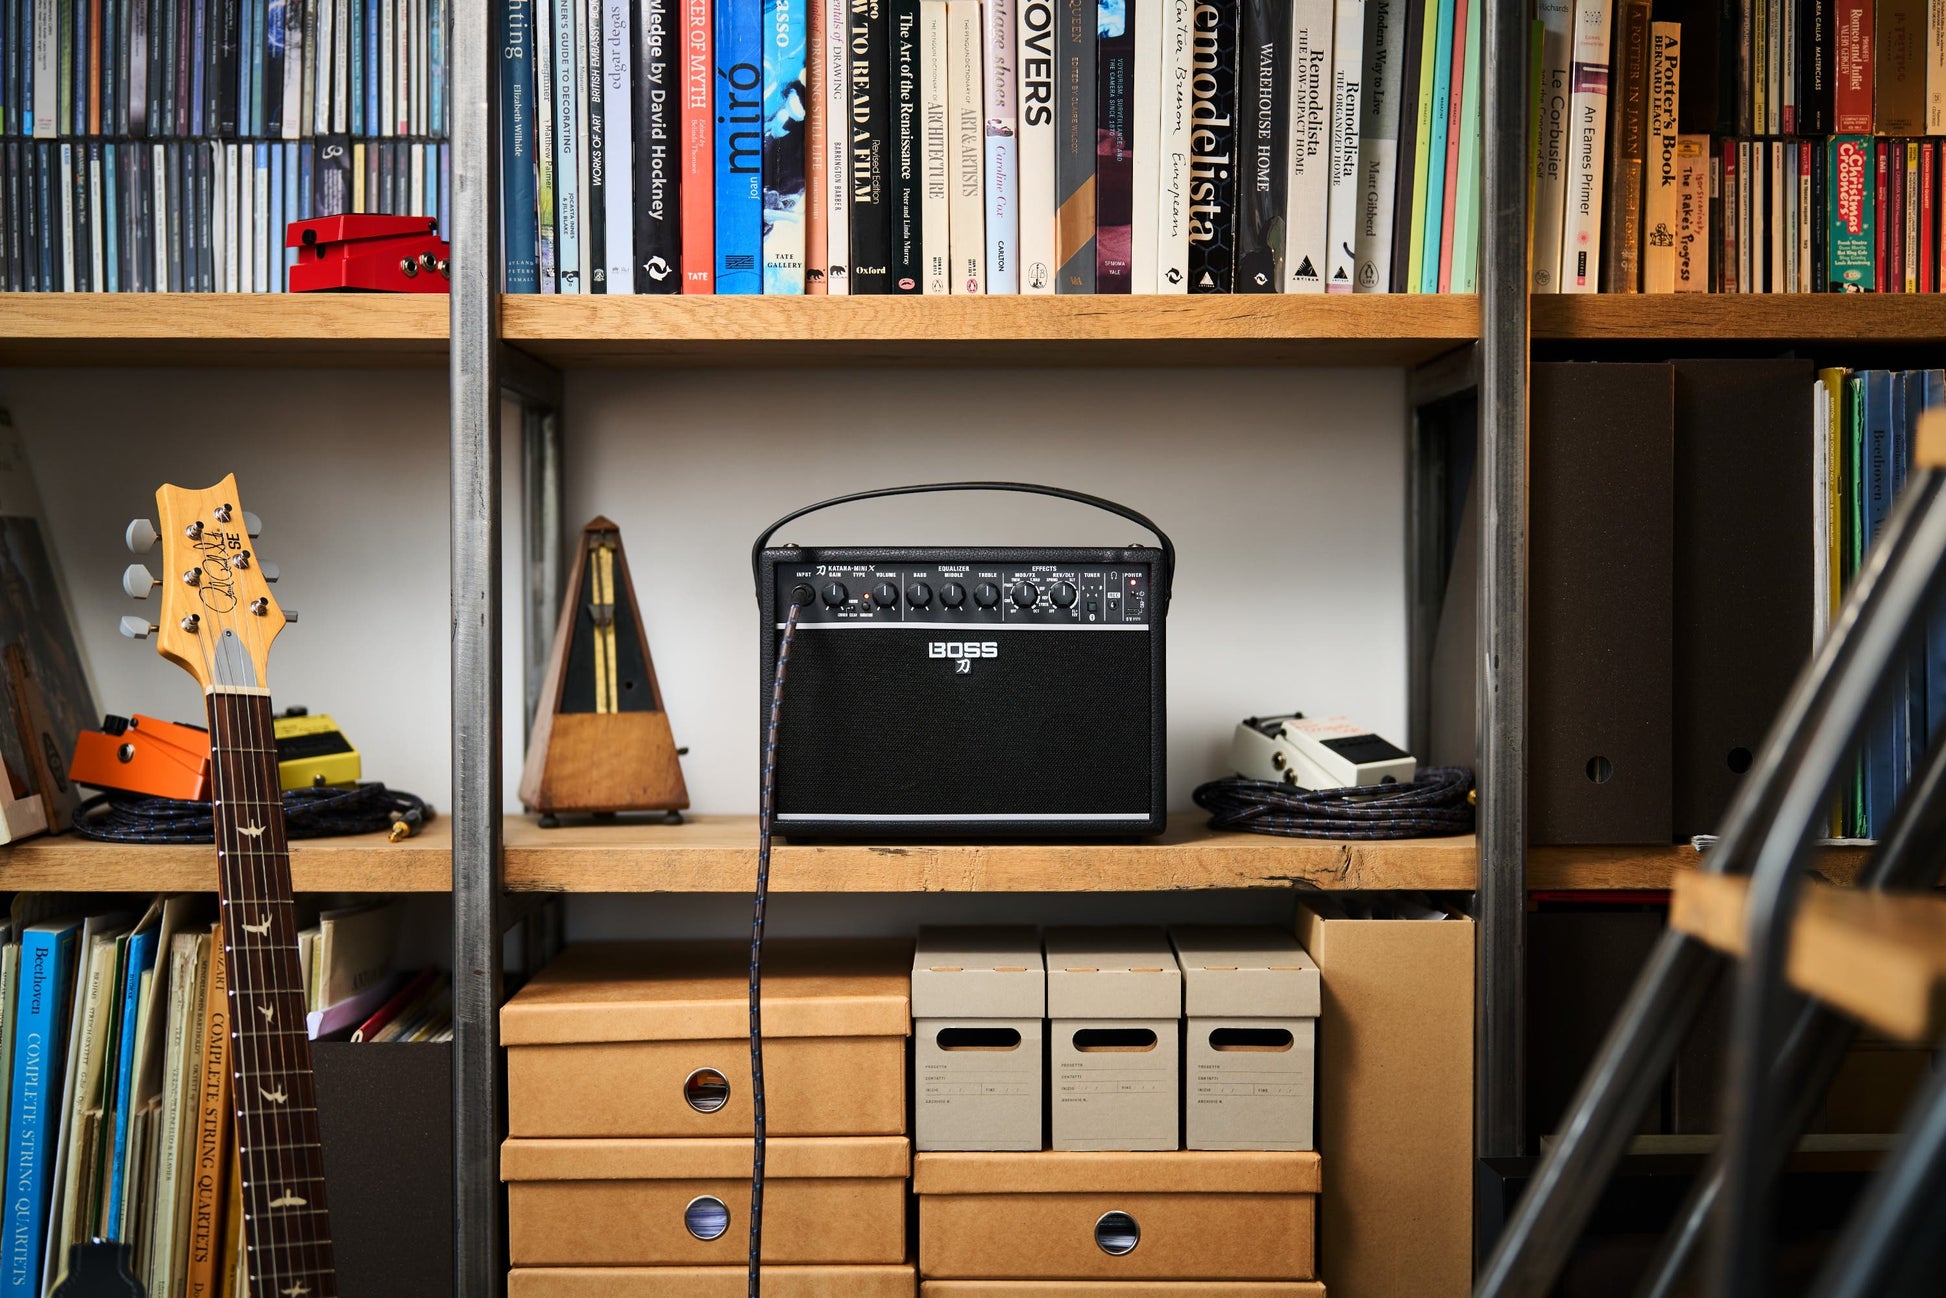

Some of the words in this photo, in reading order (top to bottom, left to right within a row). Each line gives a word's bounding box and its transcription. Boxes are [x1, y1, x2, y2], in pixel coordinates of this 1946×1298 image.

[608, 6, 627, 46] degas
[899, 12, 913, 39] The
[1375, 2, 1389, 46] Modern
[1632, 10, 1642, 19] A
[1815, 17, 1823, 42] CALLAS
[1851, 9, 1863, 43] Romeo
[561, 32, 569, 65] GUIDE
[591, 23, 600, 67] EMBASSY
[691, 30, 706, 51] OF
[832, 32, 843, 44] of
[852, 23, 869, 55] TO
[900, 40, 913, 62] Art
[1298, 28, 1308, 54] THE
[1629, 25, 1641, 79] POTTER
[1665, 35, 1677, 49] A
[1851, 44, 1862, 62] and
[541, 56, 551, 102] Beginner
[562, 69, 570, 82] TO
[608, 50, 627, 90] edgar
[647, 63, 666, 84] by
[811, 38, 822, 102] DRAWING
[833, 46, 842, 100] DRAWING
[900, 64, 914, 80] of
[1024, 0, 1052, 126] OVERS
[1372, 49, 1387, 74] Way
[1552, 69, 1566, 88] Le
[1653, 35, 1663, 94] BERNARD
[1814, 46, 1822, 91] MASTERCLASS
[1851, 63, 1861, 90] Juliet
[592, 69, 601, 103] BRITISH
[690, 55, 706, 109] MYTH
[853, 61, 870, 123] READ
[900, 81, 914, 101] the
[994, 56, 1012, 107] shoes
[1071, 85, 1078, 96] BY
[1258, 42, 1274, 139] WAREHOUSE
[1296, 57, 1307, 136] LOW-IMPACT
[1336, 70, 1345, 90] THE
[1374, 76, 1386, 88] to
[1629, 86, 1639, 102] IN
[1662, 55, 1677, 129] Potter's
[513, 84, 522, 122] Elizabeth
[561, 86, 571, 154] DECORATING
[651, 89, 667, 139] David
[717, 63, 761, 173] miró
[1307, 49, 1324, 156] Remodelista
[1372, 91, 1385, 115] Live
[1583, 106, 1596, 123] An
[1653, 97, 1662, 137] LEACH
[592, 114, 601, 132] ART
[811, 105, 822, 141] STILL
[853, 126, 870, 143] A
[960, 108, 976, 134] ART
[1188, 0, 1230, 245] emodelista
[1333, 92, 1344, 153] ORGANIZED
[1343, 81, 1360, 177] Remodelista
[1548, 96, 1565, 181] Corbusier
[1627, 107, 1638, 153] JAPAN
[514, 124, 523, 157] Wilhide
[544, 125, 553, 159] Matthew
[592, 134, 601, 149] OF
[812, 145, 822, 170] LIFE
[872, 139, 881, 174] Revised
[901, 103, 914, 180] Renaissance
[927, 102, 945, 200] ARCHITECTURE
[1296, 139, 1305, 176] HOME
[1581, 128, 1595, 170] Eames
[545, 160, 553, 190] Palmer
[593, 150, 602, 186] WORKS
[834, 142, 842, 183] BARRINGTON
[854, 148, 871, 203] FILM
[961, 145, 978, 197] ARTISTS
[995, 145, 1007, 193] Caroline
[1256, 146, 1271, 192] HOME
[1333, 156, 1341, 186] HOME
[1367, 161, 1380, 189] Matt
[1662, 135, 1676, 187] Book
[1682, 167, 1693, 187] The
[1839, 144, 1854, 214] Crooners
[647, 145, 666, 220] Hockney
[748, 176, 759, 200] joan
[834, 186, 842, 211] BARBER
[873, 176, 881, 205] Edition
[903, 188, 911, 205] Peter
[1580, 174, 1593, 216] Primer
[1848, 154, 1862, 233] Christmas
[903, 205, 911, 219] and
[995, 196, 1007, 218] Cox
[1366, 192, 1379, 237] Gibberd
[1681, 194, 1692, 231] Rake's
[903, 220, 911, 239] Linda
[856, 266, 886, 274] Oxford
[902, 240, 911, 266] Murray
[1679, 235, 1695, 282] Progress
[687, 272, 708, 281] TATE
[1873, 429, 1886, 501] Beethoven
[227, 532, 241, 551] SE
[816, 565, 827, 576] 刀
[928, 642, 998, 658] BOSS
[956, 658, 970, 673] 刀
[31, 947, 49, 1015] Beethoven
[204, 1012, 225, 1103] COMPLETE
[22, 1032, 42, 1125] COMPLETE
[201, 1107, 219, 1169] STRING
[18, 1129, 36, 1191] STRING
[194, 1175, 215, 1263] QUARTETS
[12, 1197, 31, 1286] QUARTETS
